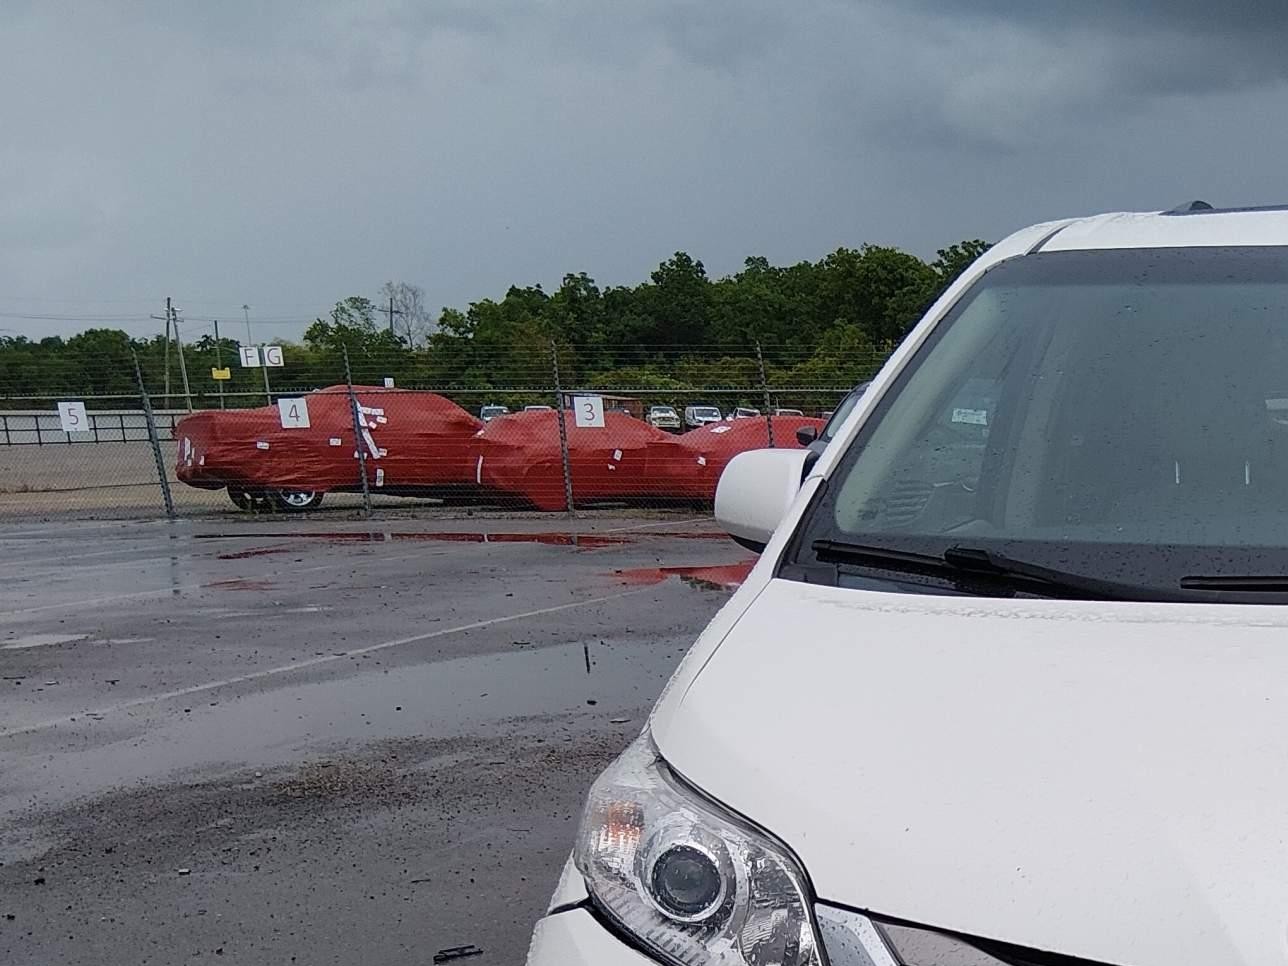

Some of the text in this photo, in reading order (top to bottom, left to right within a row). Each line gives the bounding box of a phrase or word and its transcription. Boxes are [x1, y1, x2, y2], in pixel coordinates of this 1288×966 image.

[244, 348, 255, 366] F
[267, 347, 281, 365] G
[67, 407, 79, 425] 5
[289, 404, 301, 422] 4
[583, 402, 596, 421] 3
